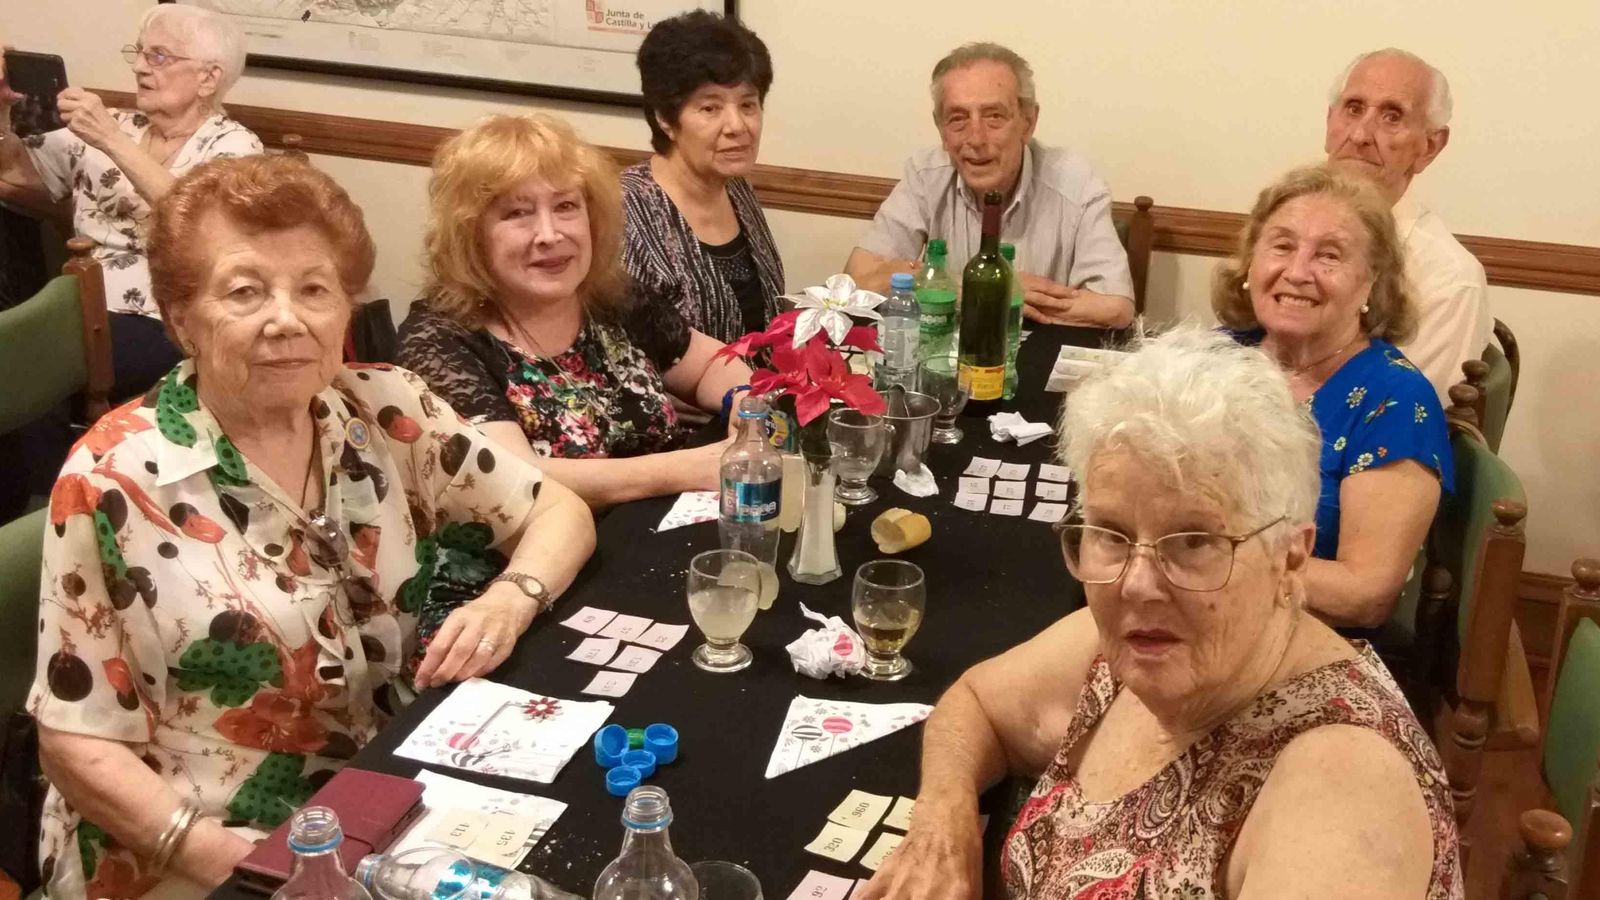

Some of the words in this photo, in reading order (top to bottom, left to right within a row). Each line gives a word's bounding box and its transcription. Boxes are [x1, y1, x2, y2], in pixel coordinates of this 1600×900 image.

[606, 9, 630, 18] Junta
[633, 11, 645, 20] de
[605, 17, 637, 28] Castilla
[639, 22, 645, 30] y
[851, 802, 870, 818] 960
[450, 823, 470, 838] 113
[496, 830, 516, 847] 135
[824, 837, 843, 853] 320
